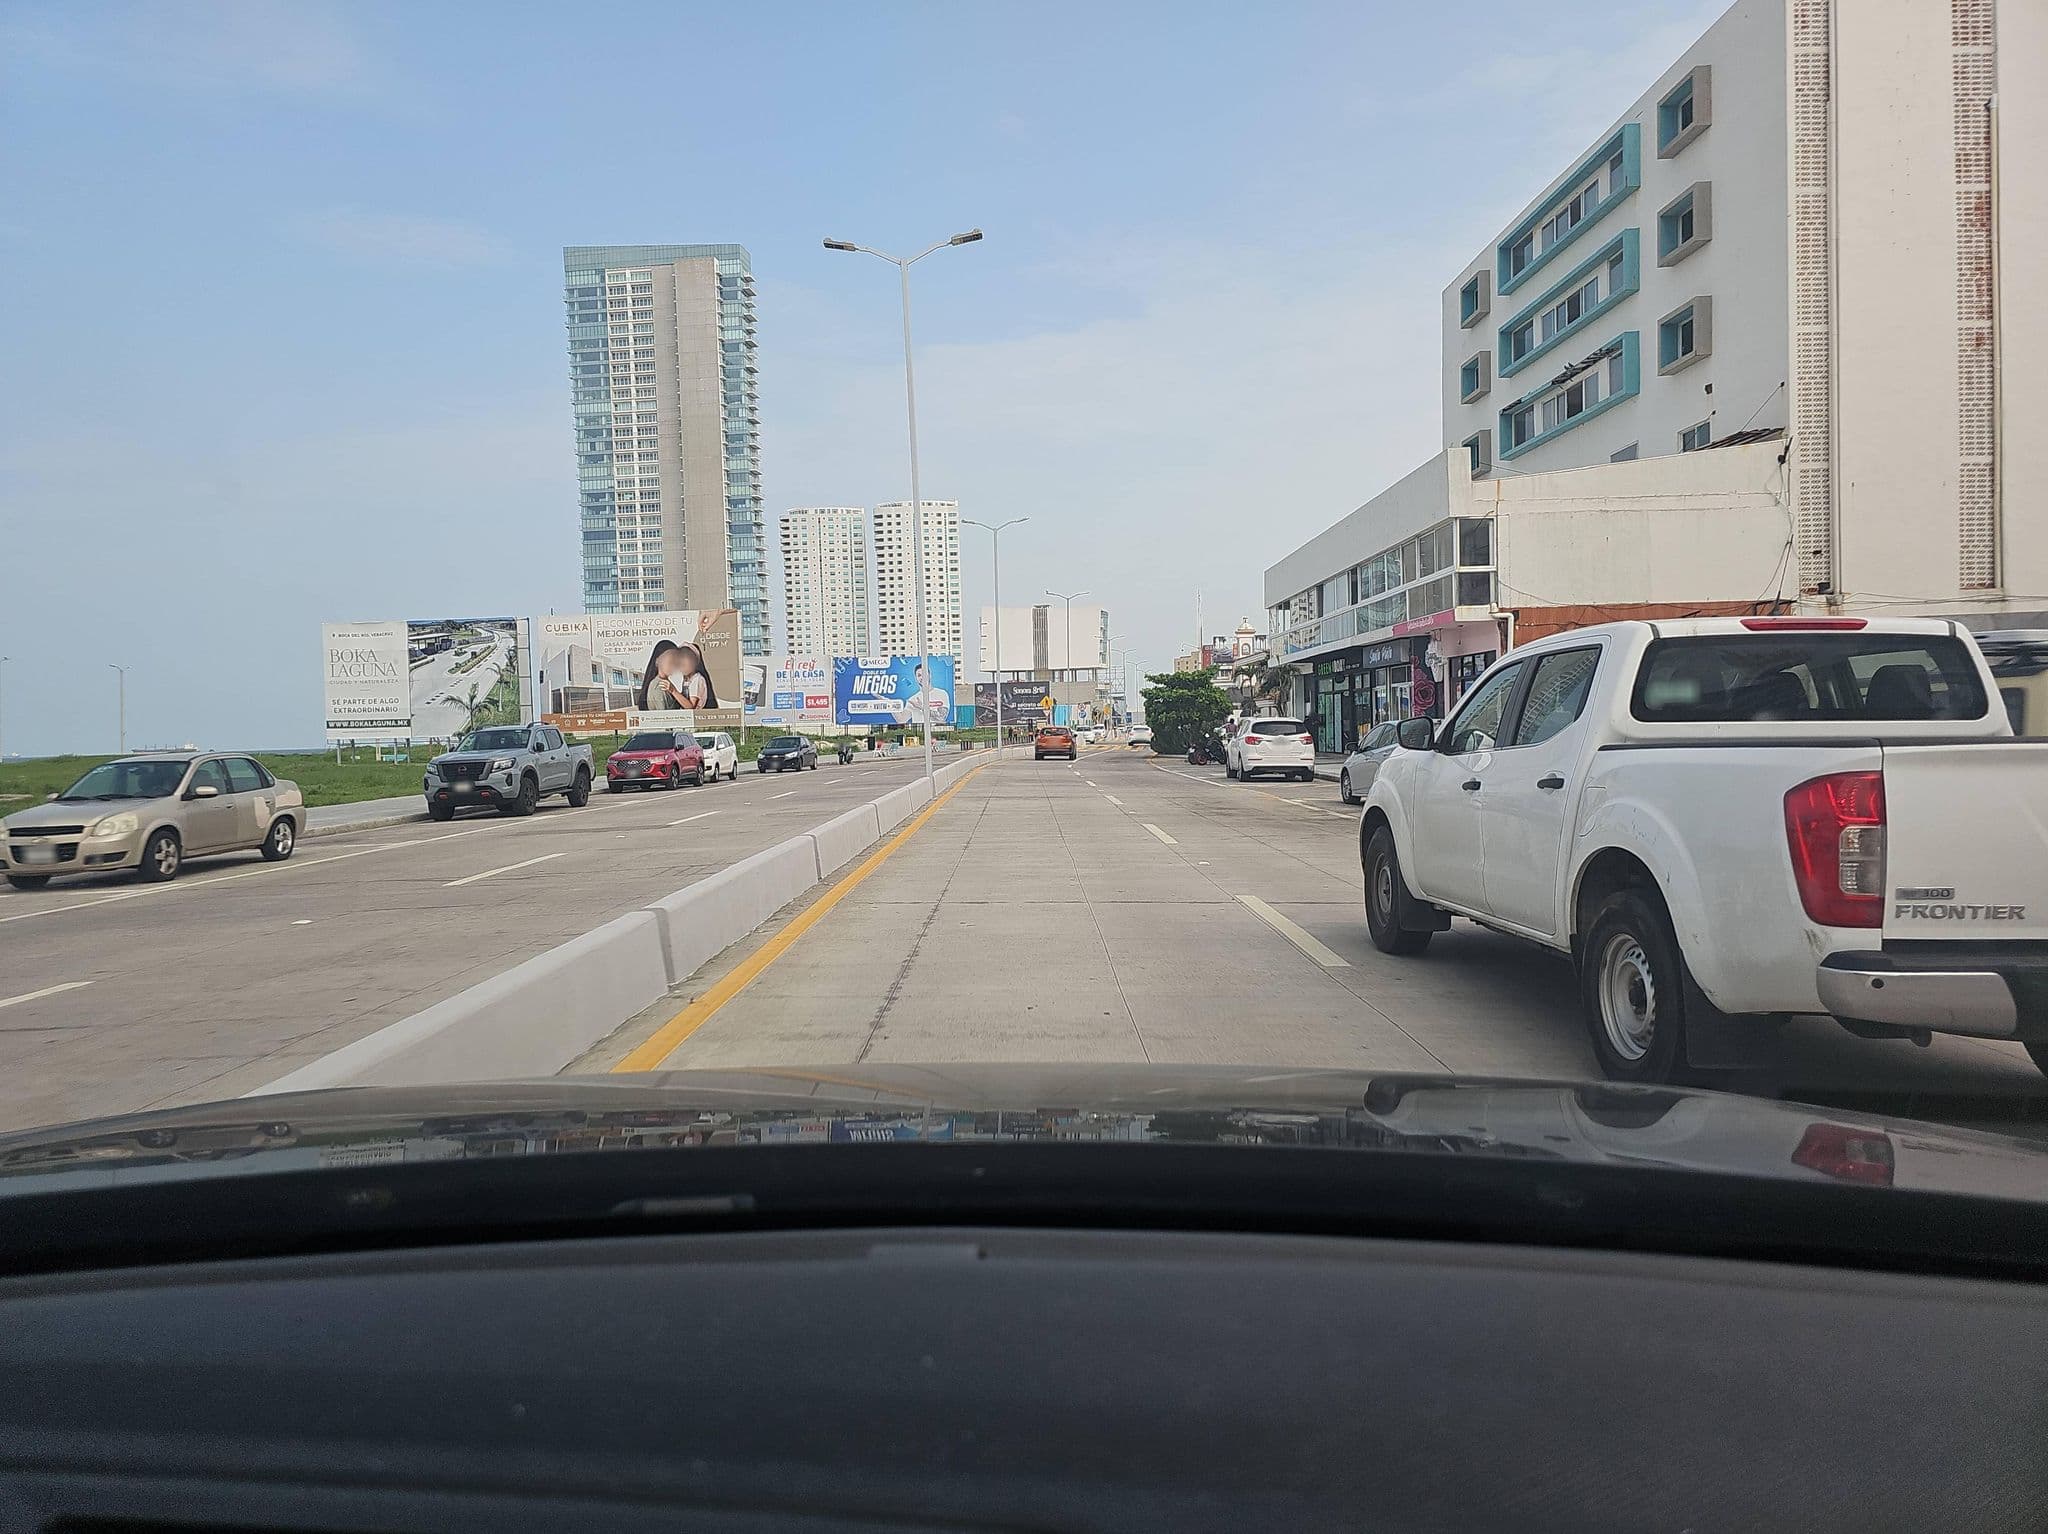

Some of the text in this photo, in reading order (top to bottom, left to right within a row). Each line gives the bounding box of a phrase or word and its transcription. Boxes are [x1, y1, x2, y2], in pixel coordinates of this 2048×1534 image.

[545, 622, 589, 633] CUBIKA
[605, 618, 661, 628] COMIENZO
[664, 618, 678, 626] DE
[681, 617, 693, 625] TU
[597, 628, 677, 638] MEJOR HISTORIA
[706, 632, 731, 640] DESDE
[330, 648, 378, 663] BOKA
[330, 662, 399, 678] LAGUNA
[797, 661, 815, 672] rey
[776, 670, 787, 679] DE
[802, 669, 825, 678] CASA
[852, 674, 898, 695] MEGAS
[333, 706, 399, 714] EXTRAORDINARIO
[328, 719, 408, 728] WWW.BOKALAGUNA.MX
[1895, 903, 2025, 920] FRONTIER
